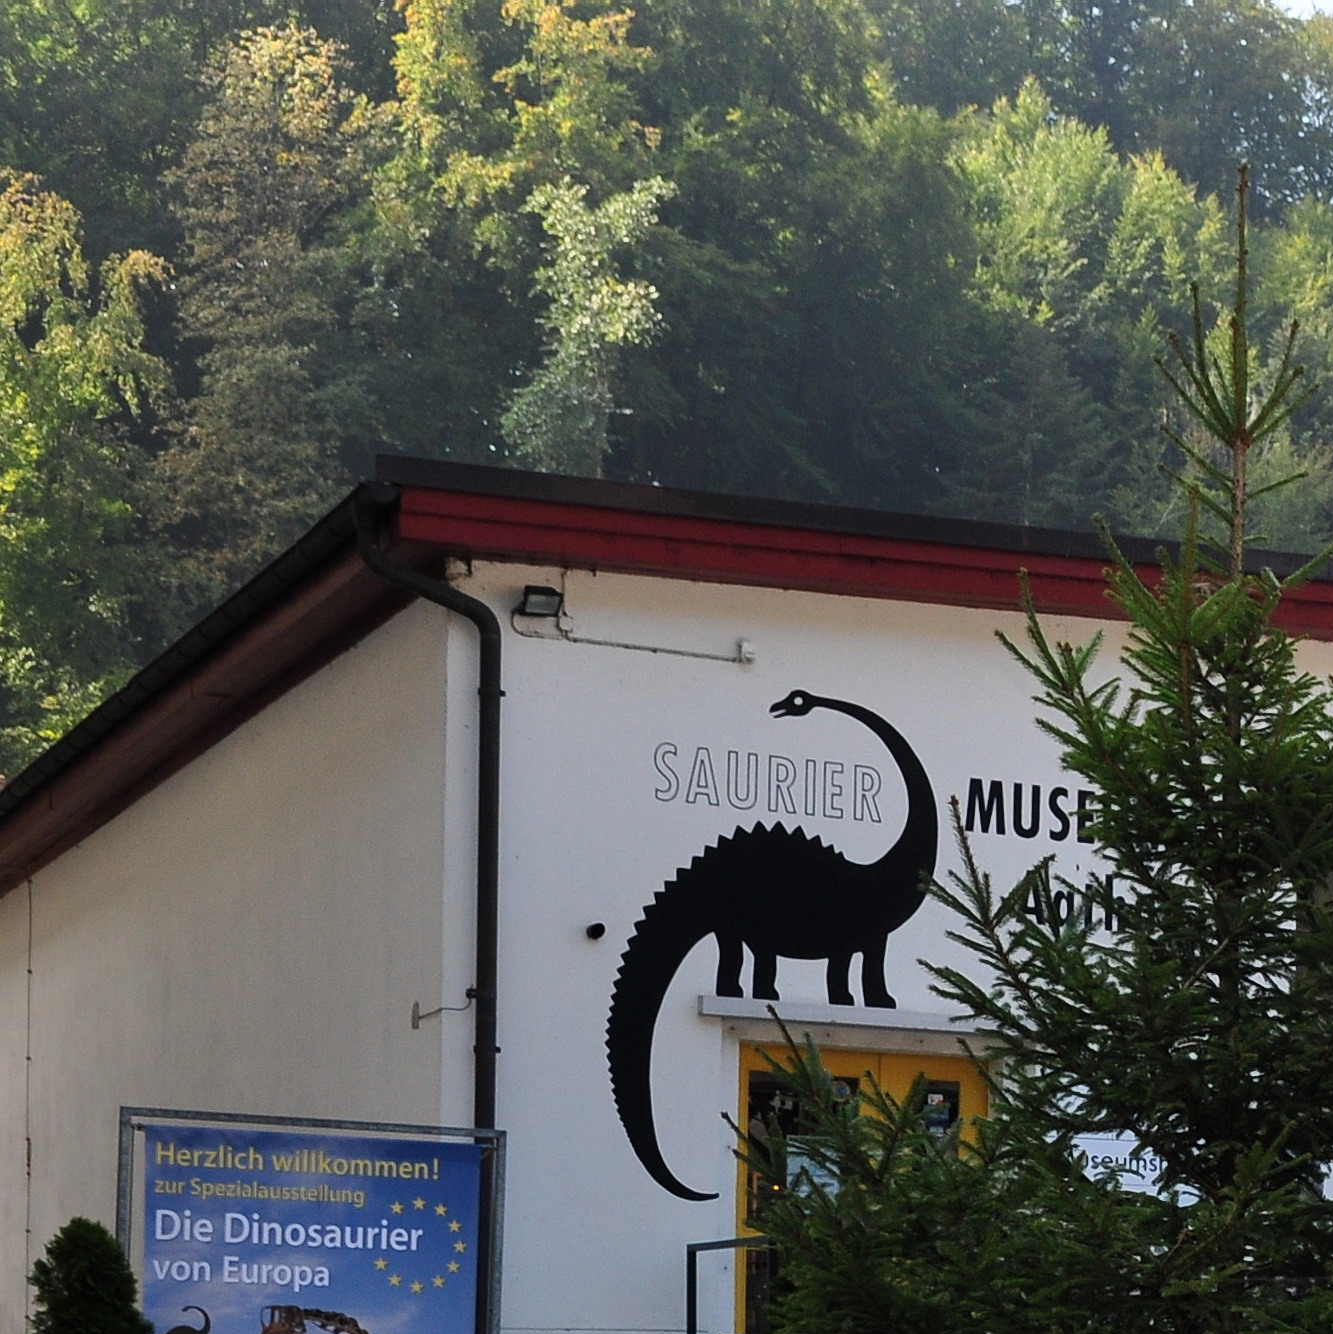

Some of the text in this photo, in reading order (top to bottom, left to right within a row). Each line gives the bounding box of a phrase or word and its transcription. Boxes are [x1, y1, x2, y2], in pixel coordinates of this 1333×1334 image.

[653, 741, 883, 824] SAURIER
[965, 777, 1097, 844] MUSE
[155, 1142, 440, 1181] Herzlich willkommen!
[154, 1177, 366, 1208] zur Spezialausstellung
[154, 1208, 424, 1251] Die Dinosaurier
[153, 1255, 331, 1293] von Europa
